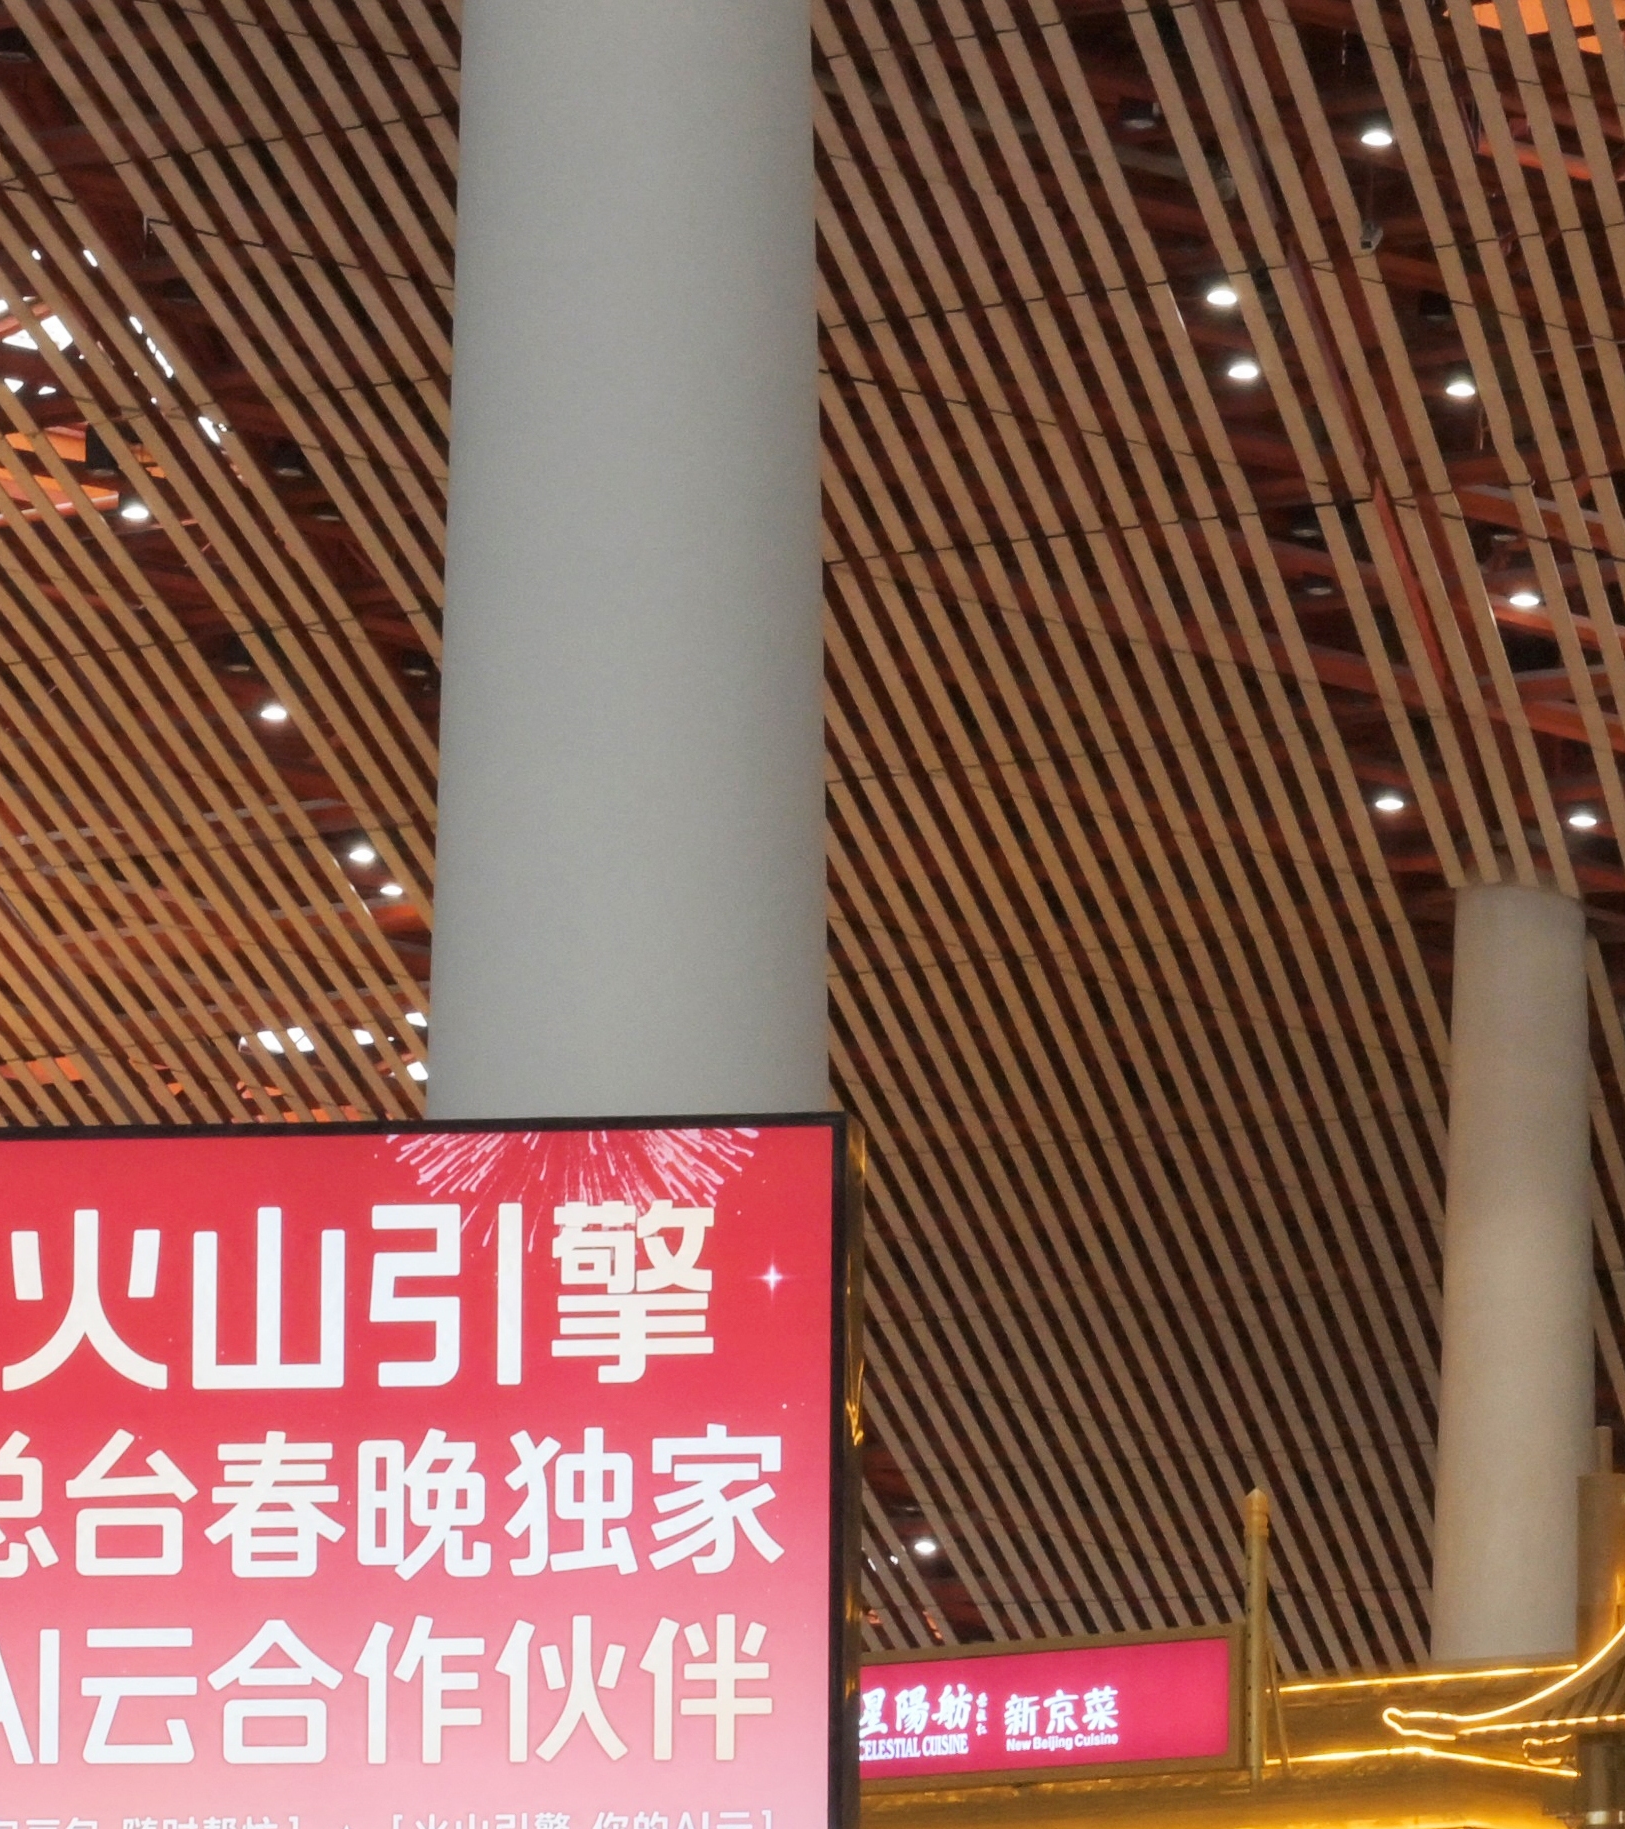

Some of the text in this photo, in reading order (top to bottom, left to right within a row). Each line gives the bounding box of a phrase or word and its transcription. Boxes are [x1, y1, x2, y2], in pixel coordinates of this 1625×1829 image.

[3, 1201, 715, 1391] 火山引擎
[1004, 1686, 1119, 1736] 新京菜
[922, 1733, 968, 1756] CUISINE
[1006, 1728, 1118, 1751] New Beijing Cuisine
